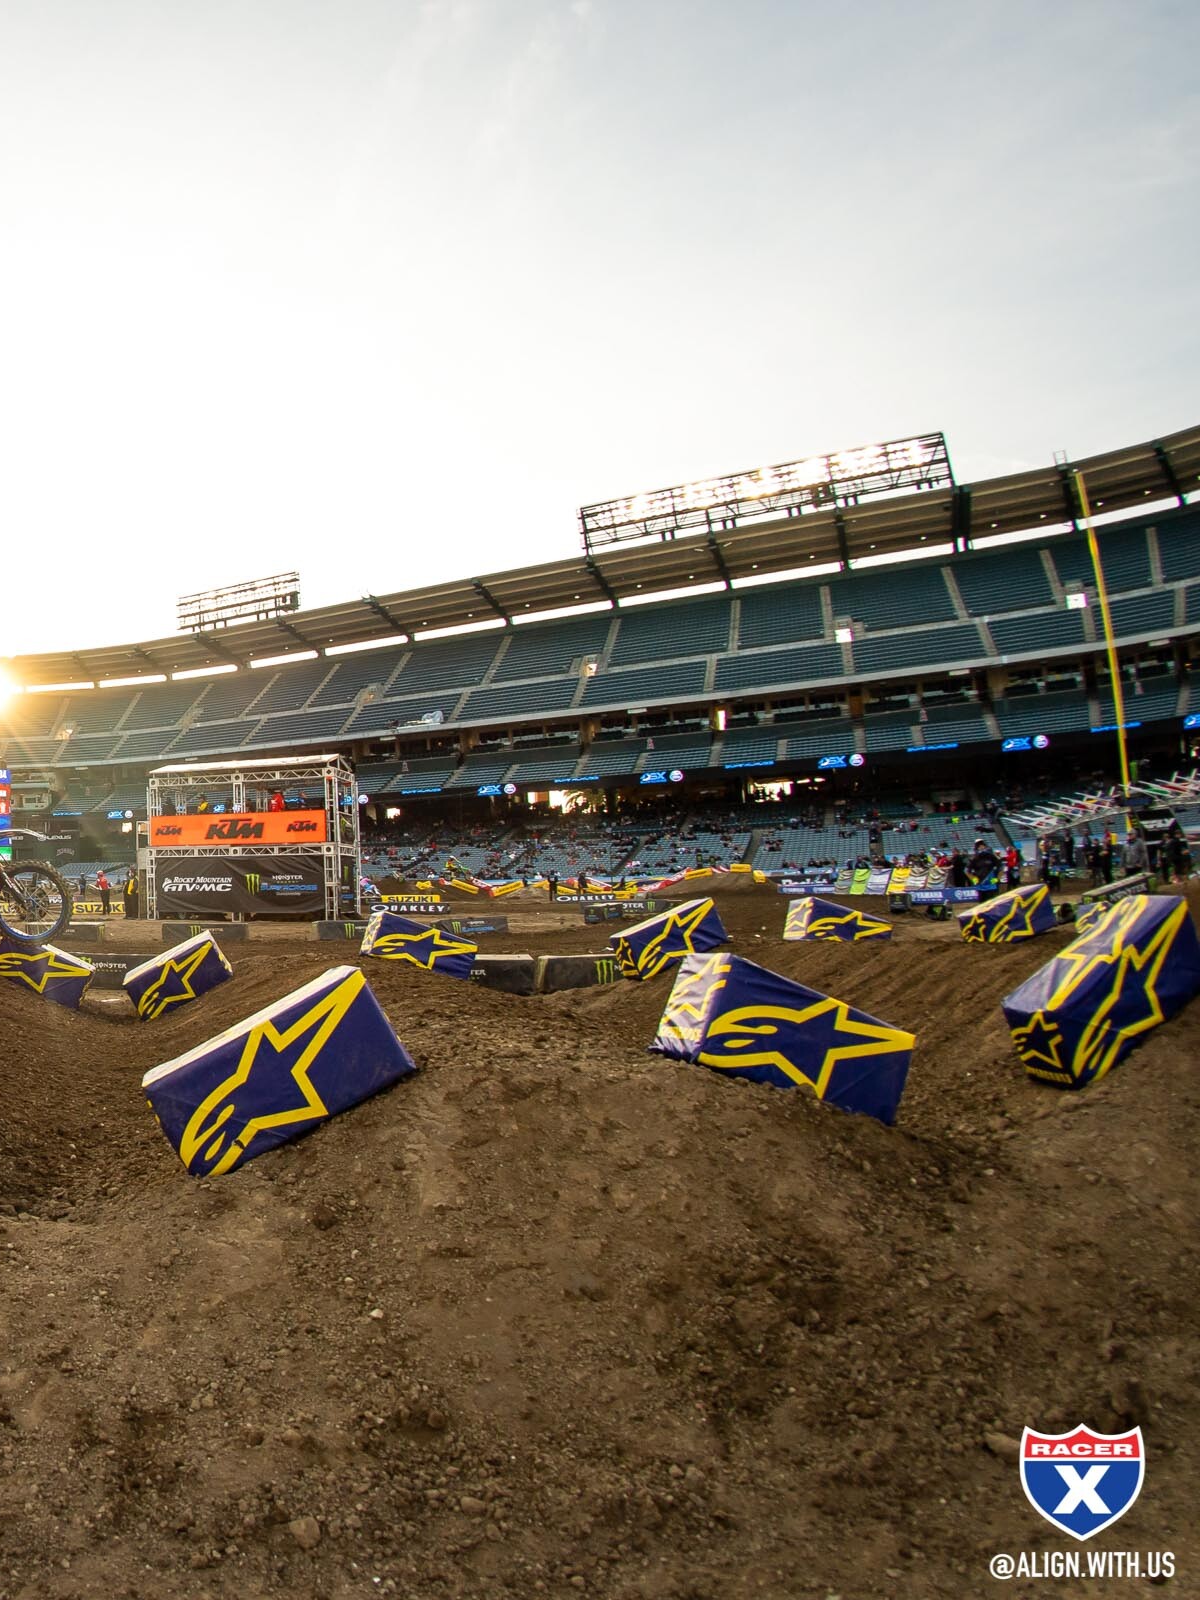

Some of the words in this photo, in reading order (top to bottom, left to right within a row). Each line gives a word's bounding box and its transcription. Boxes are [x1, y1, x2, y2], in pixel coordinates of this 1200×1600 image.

[155, 825, 182, 835] KTM
[205, 818, 265, 839] KTM
[287, 820, 318, 832] KTM
[916, 891, 943, 899] YAMAHA
[75, 903, 126, 914] SUZKI
[390, 904, 446, 912] OAKLEY
[92, 962, 127, 970] MONSTER
